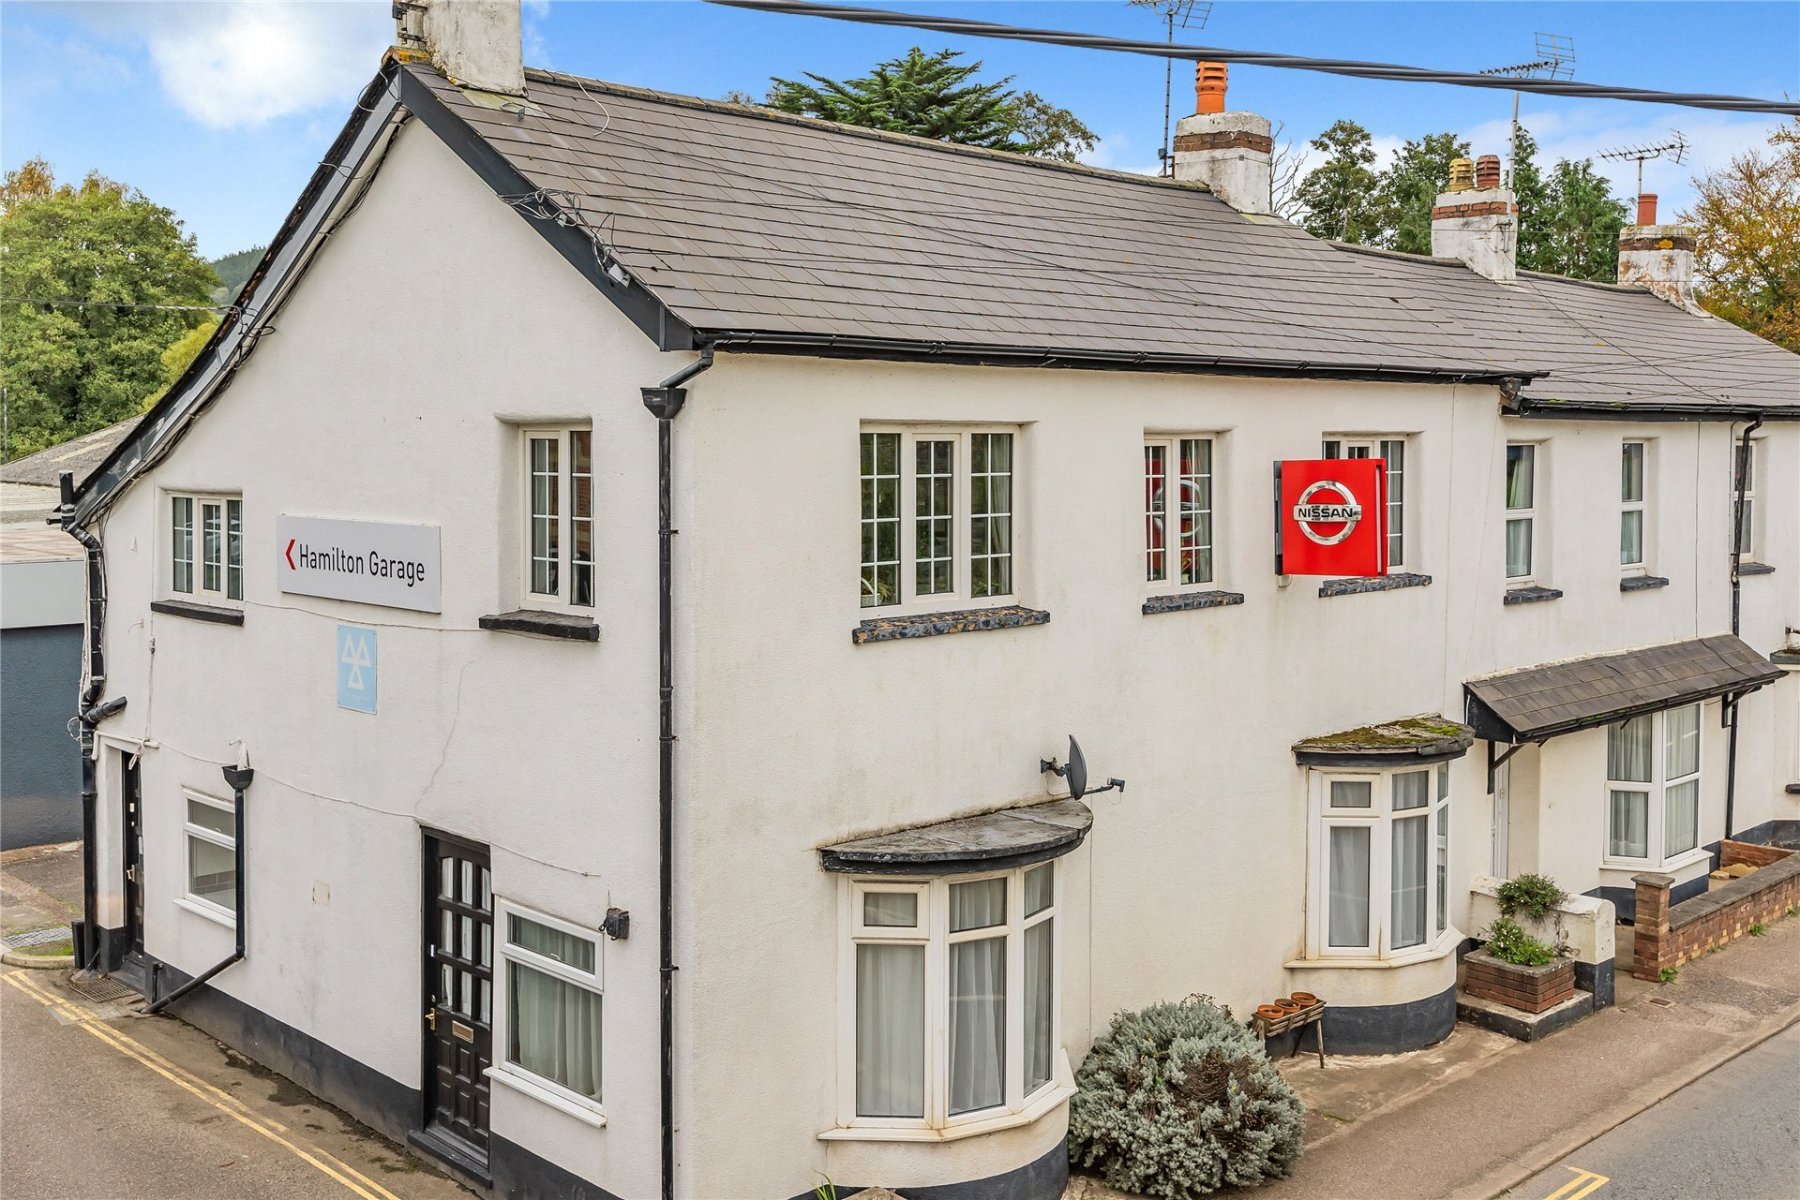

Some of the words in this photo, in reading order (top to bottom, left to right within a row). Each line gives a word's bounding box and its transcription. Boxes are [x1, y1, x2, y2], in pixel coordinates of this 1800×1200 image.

[1298, 507, 1353, 518] NISSAN
[299, 543, 364, 574] Hamilton
[369, 550, 425, 587] Garage
